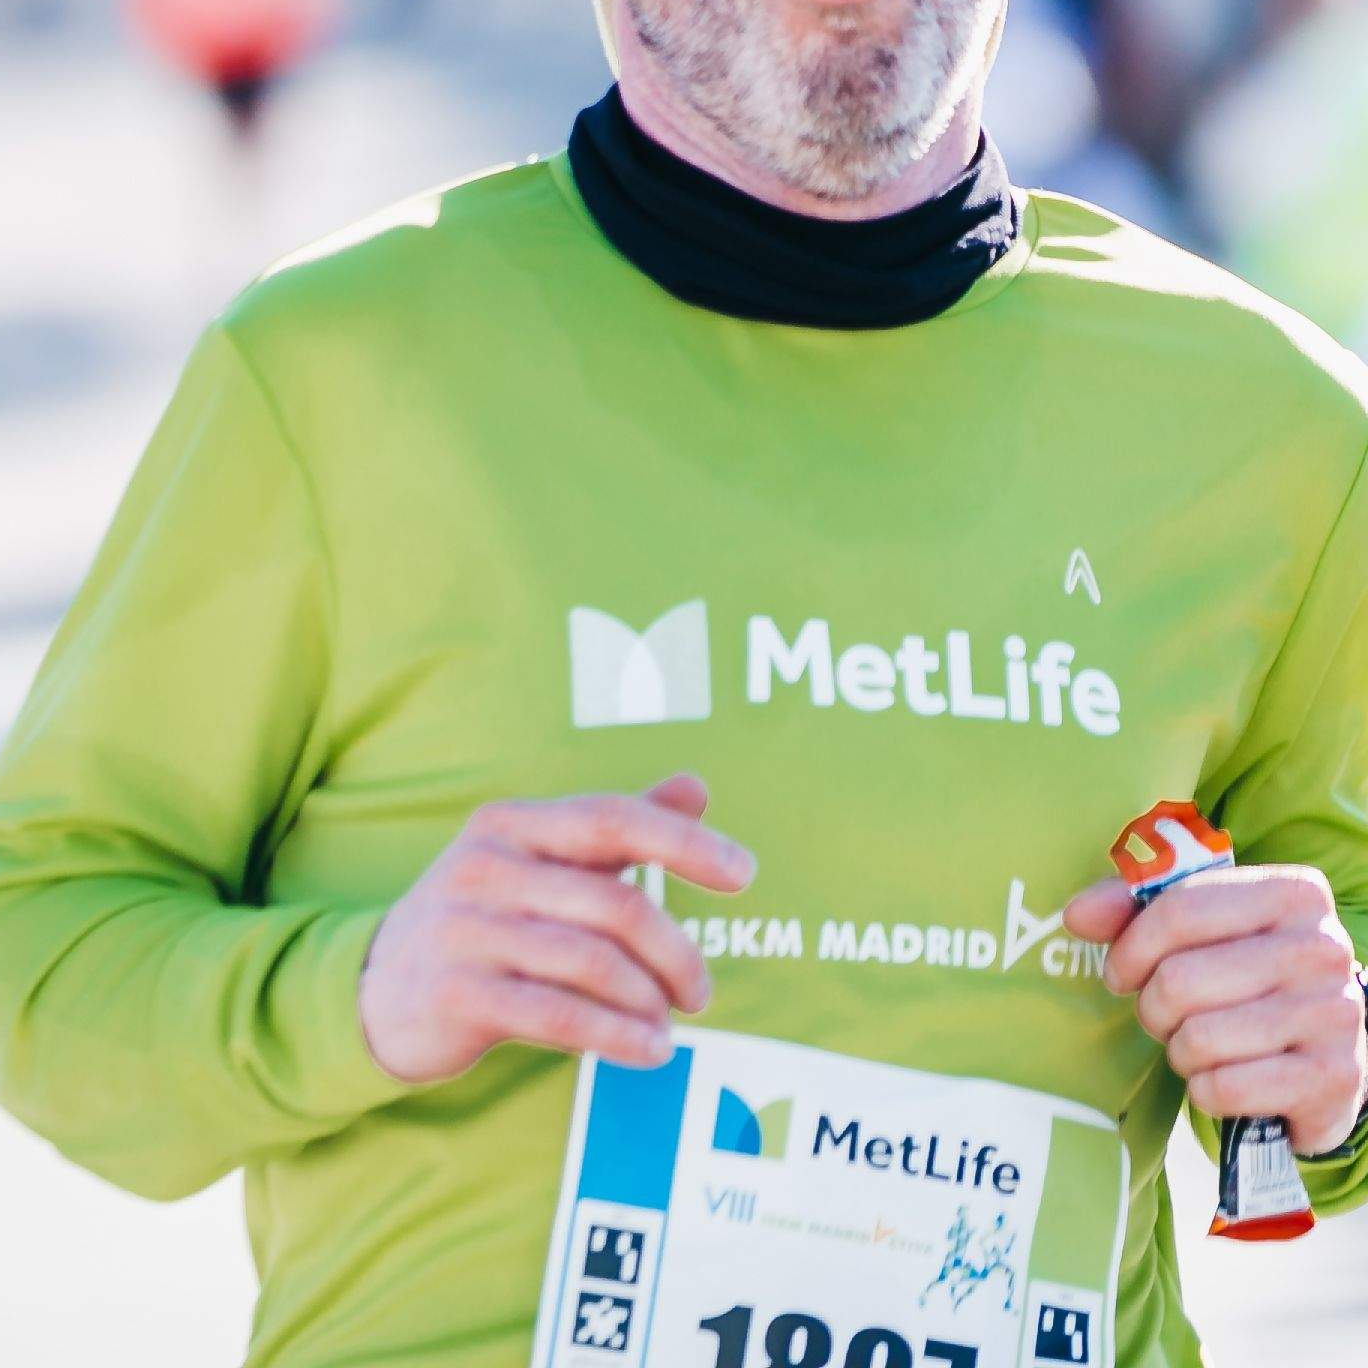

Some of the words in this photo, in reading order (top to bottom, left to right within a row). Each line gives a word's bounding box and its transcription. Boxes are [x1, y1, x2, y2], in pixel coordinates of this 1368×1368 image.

[746, 614, 1122, 737] MetLife
[817, 917, 997, 970] MADRID
[811, 1113, 1022, 1196] MetLife
[704, 1185, 757, 1223] VIII
